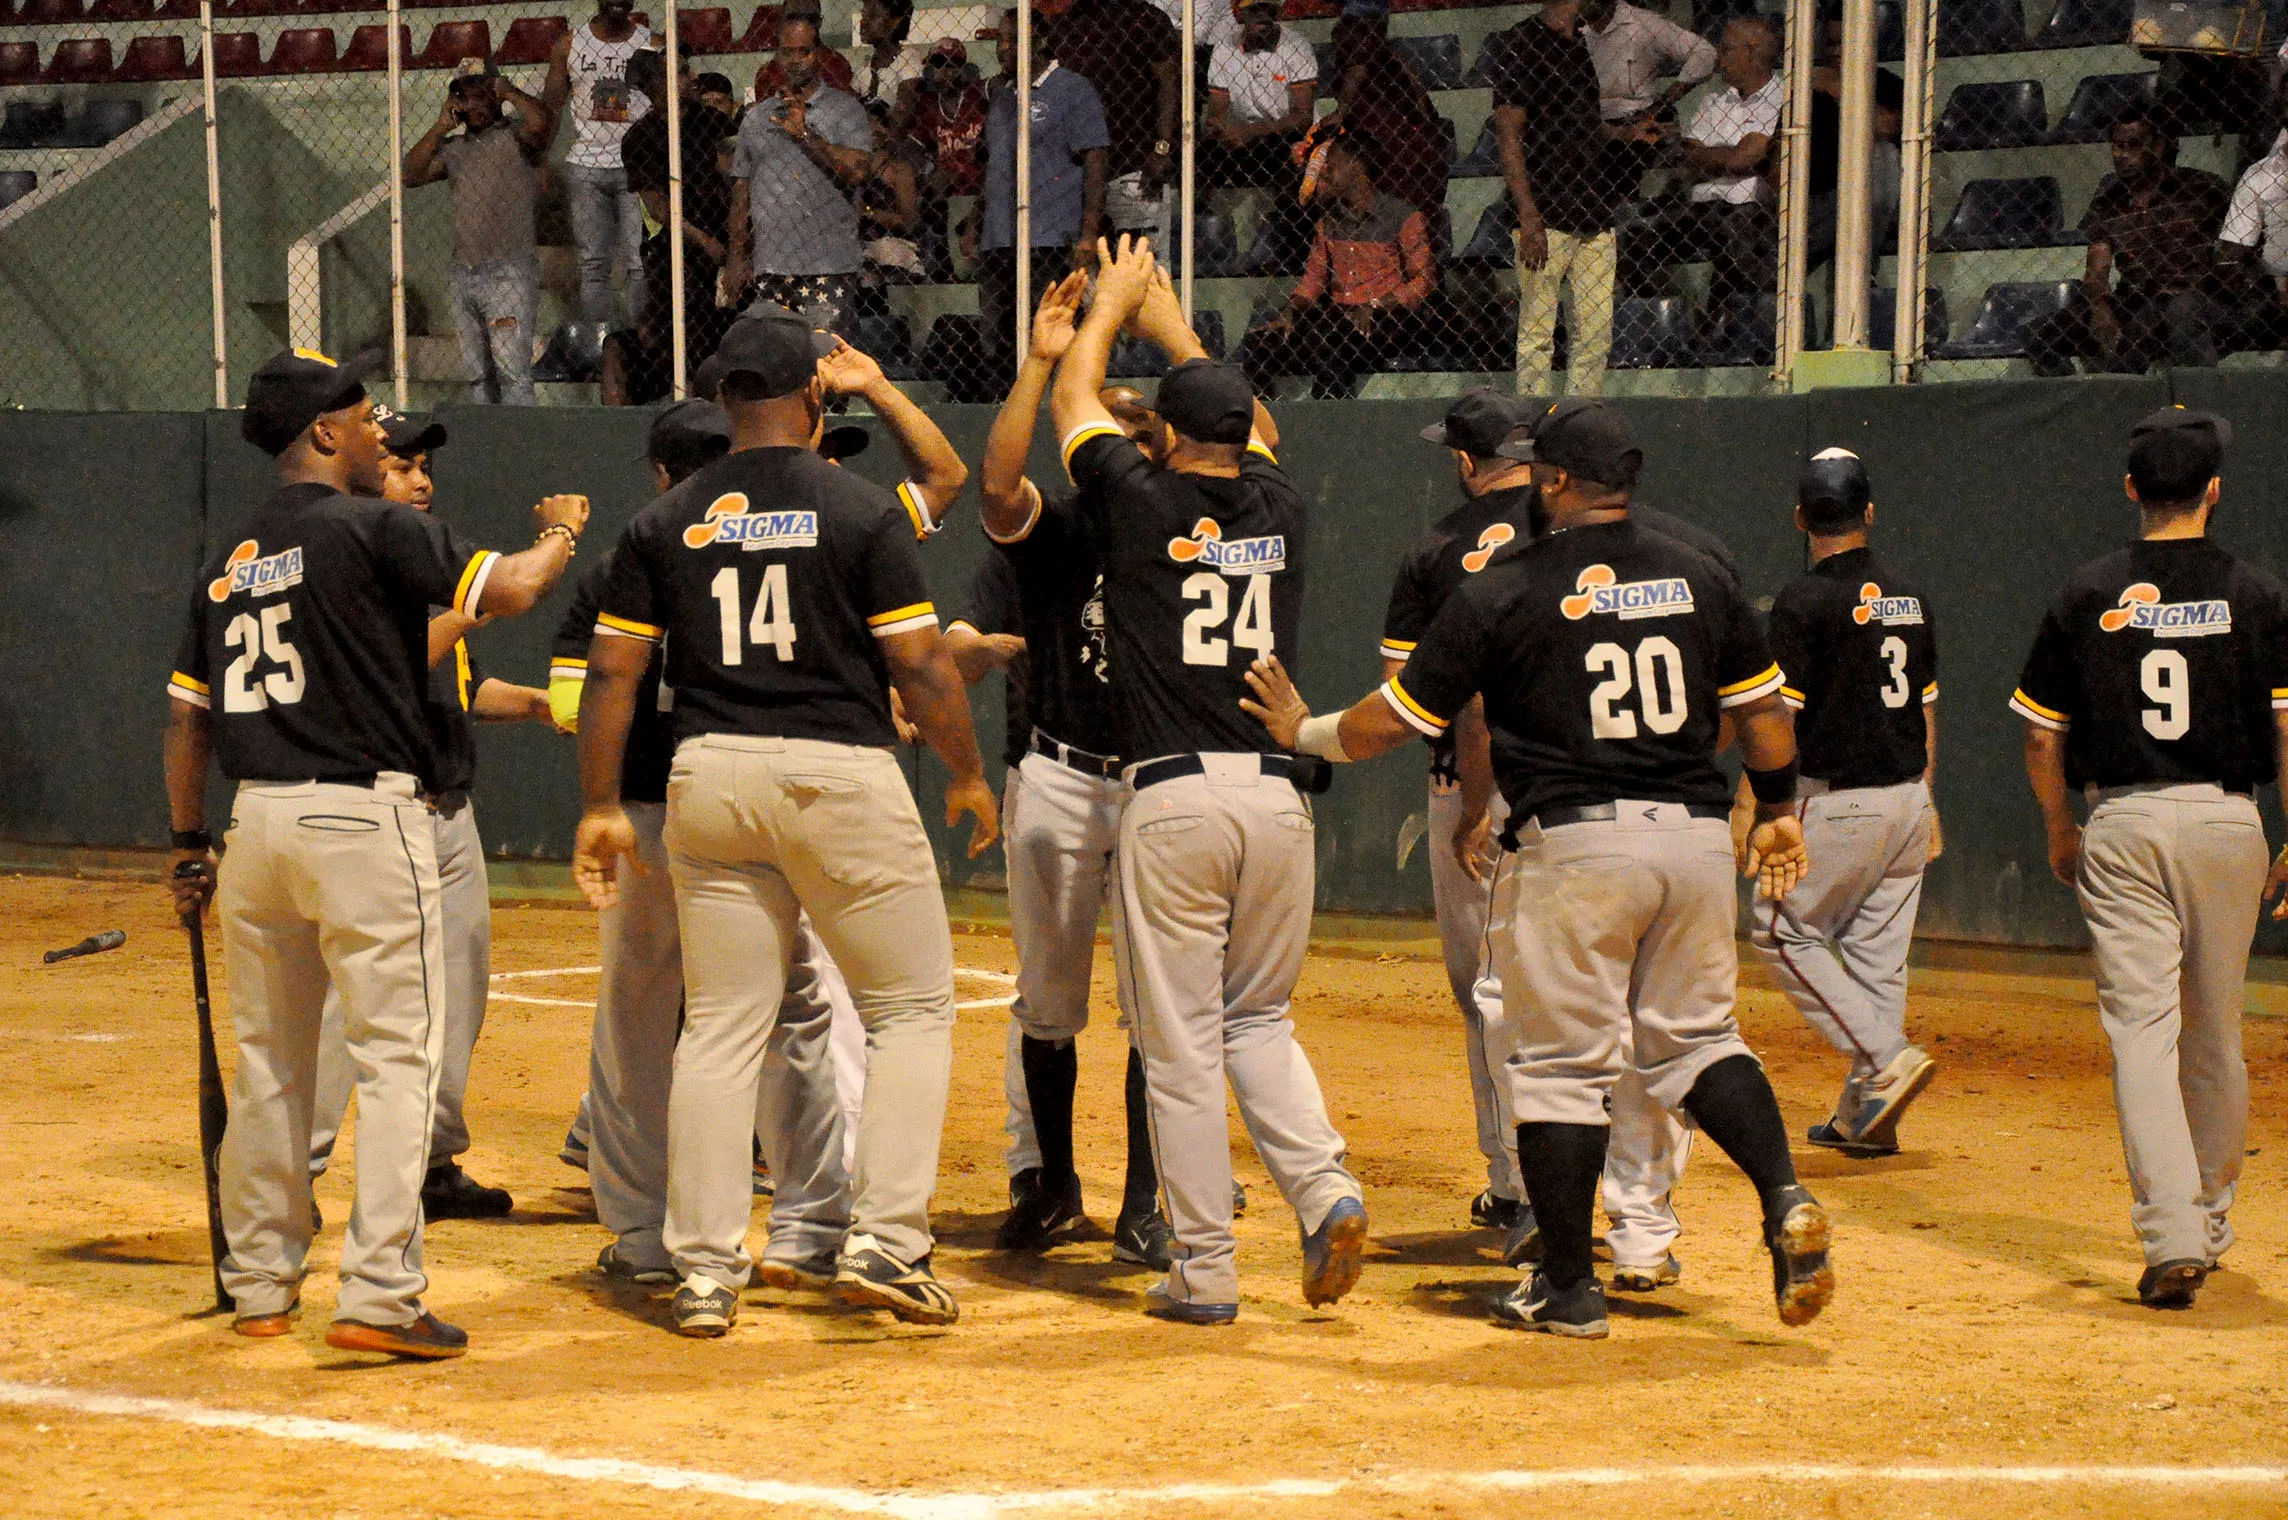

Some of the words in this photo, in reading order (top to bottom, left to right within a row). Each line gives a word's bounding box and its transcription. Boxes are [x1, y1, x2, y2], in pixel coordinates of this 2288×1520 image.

[581, 54, 597, 72] La
[714, 514, 814, 541] SIGMA
[1200, 535, 1284, 564] SIGMA
[234, 550, 302, 590] SIGMA
[1594, 581, 1690, 612] SIGMA
[1872, 600, 1920, 618] SIGMA
[711, 564, 797, 666] 14
[1182, 572, 1274, 667] 24
[2134, 603, 2229, 627] SIGMA
[224, 602, 306, 713] 25
[1880, 636, 1909, 708] 3
[1584, 635, 1689, 740] 20
[2140, 649, 2190, 740] 9
[682, 1299, 723, 1309] Reebok
